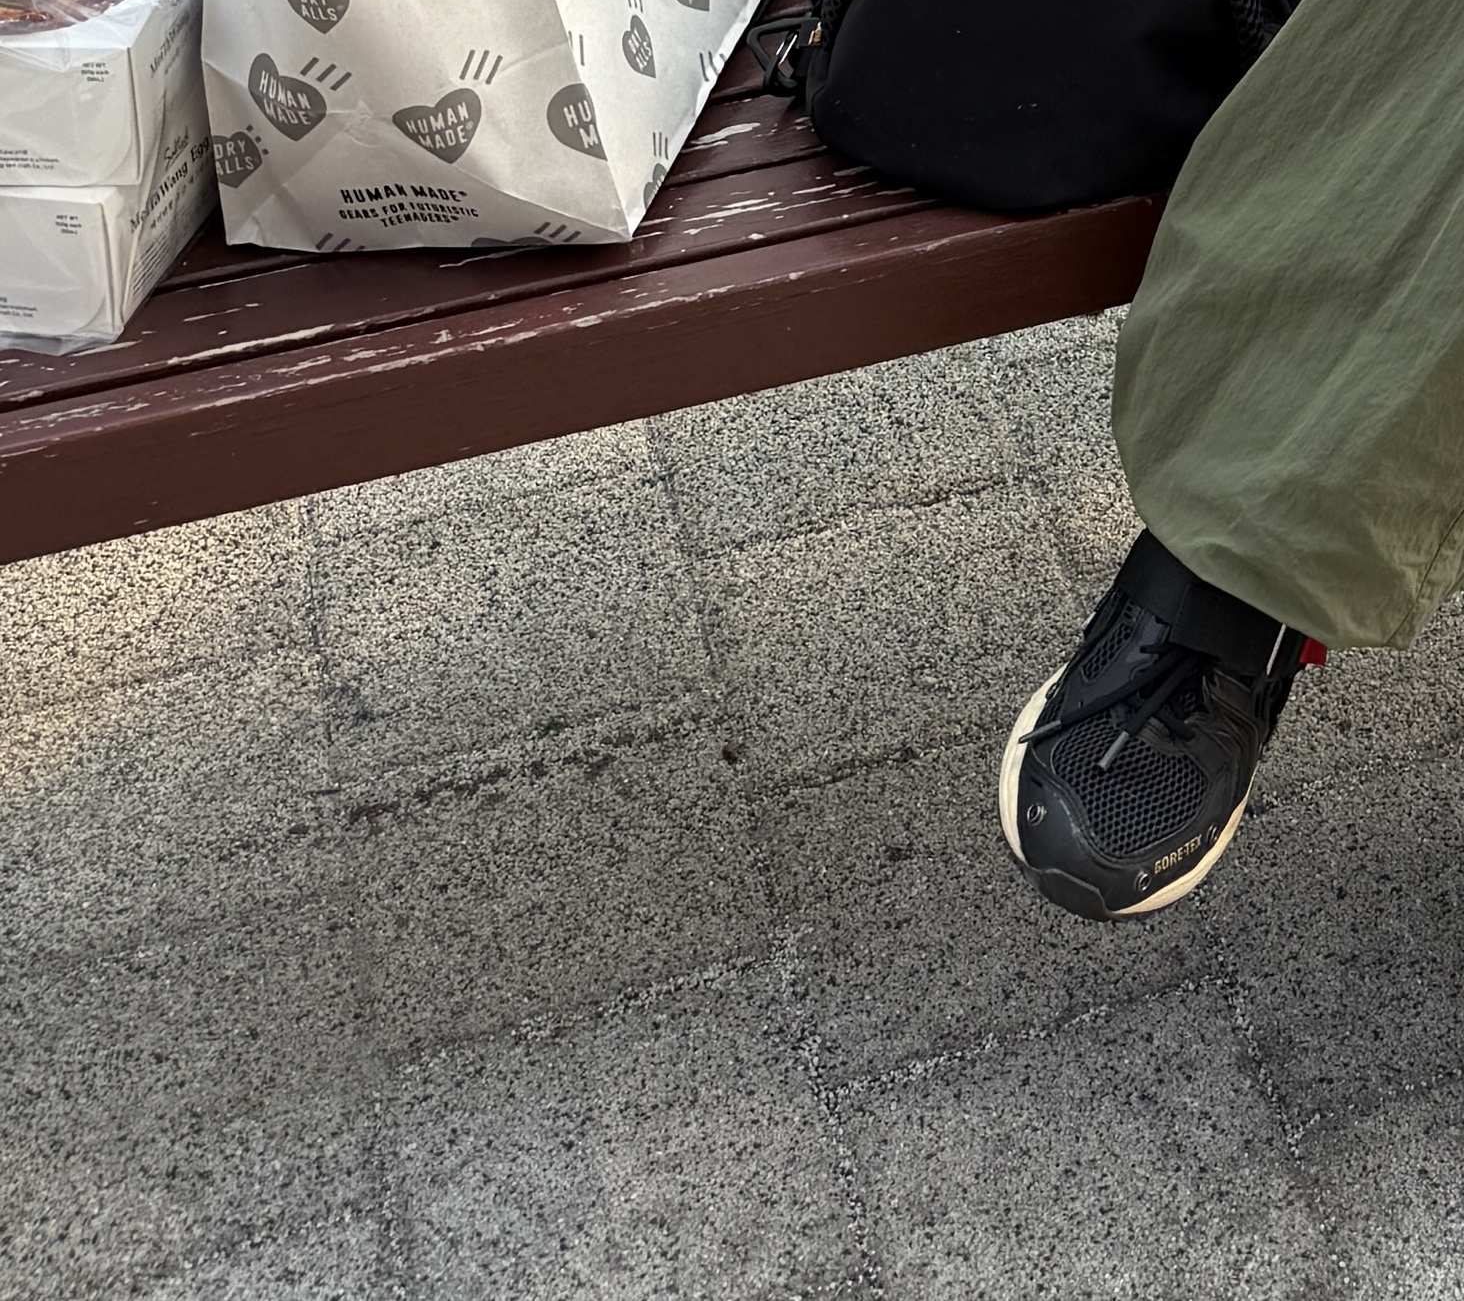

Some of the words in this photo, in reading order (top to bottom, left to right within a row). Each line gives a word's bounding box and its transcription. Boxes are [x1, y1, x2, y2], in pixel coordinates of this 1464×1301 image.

[300, 4, 338, 22] ALLS
[259, 69, 311, 111] HUMAN
[405, 101, 469, 134] HUMAN
[213, 138, 246, 159] DRY
[340, 183, 408, 204] HUMAN
[339, 208, 380, 220] GEARS
[381, 201, 407, 216] FOR
[409, 201, 480, 218] FUTURISTIC
